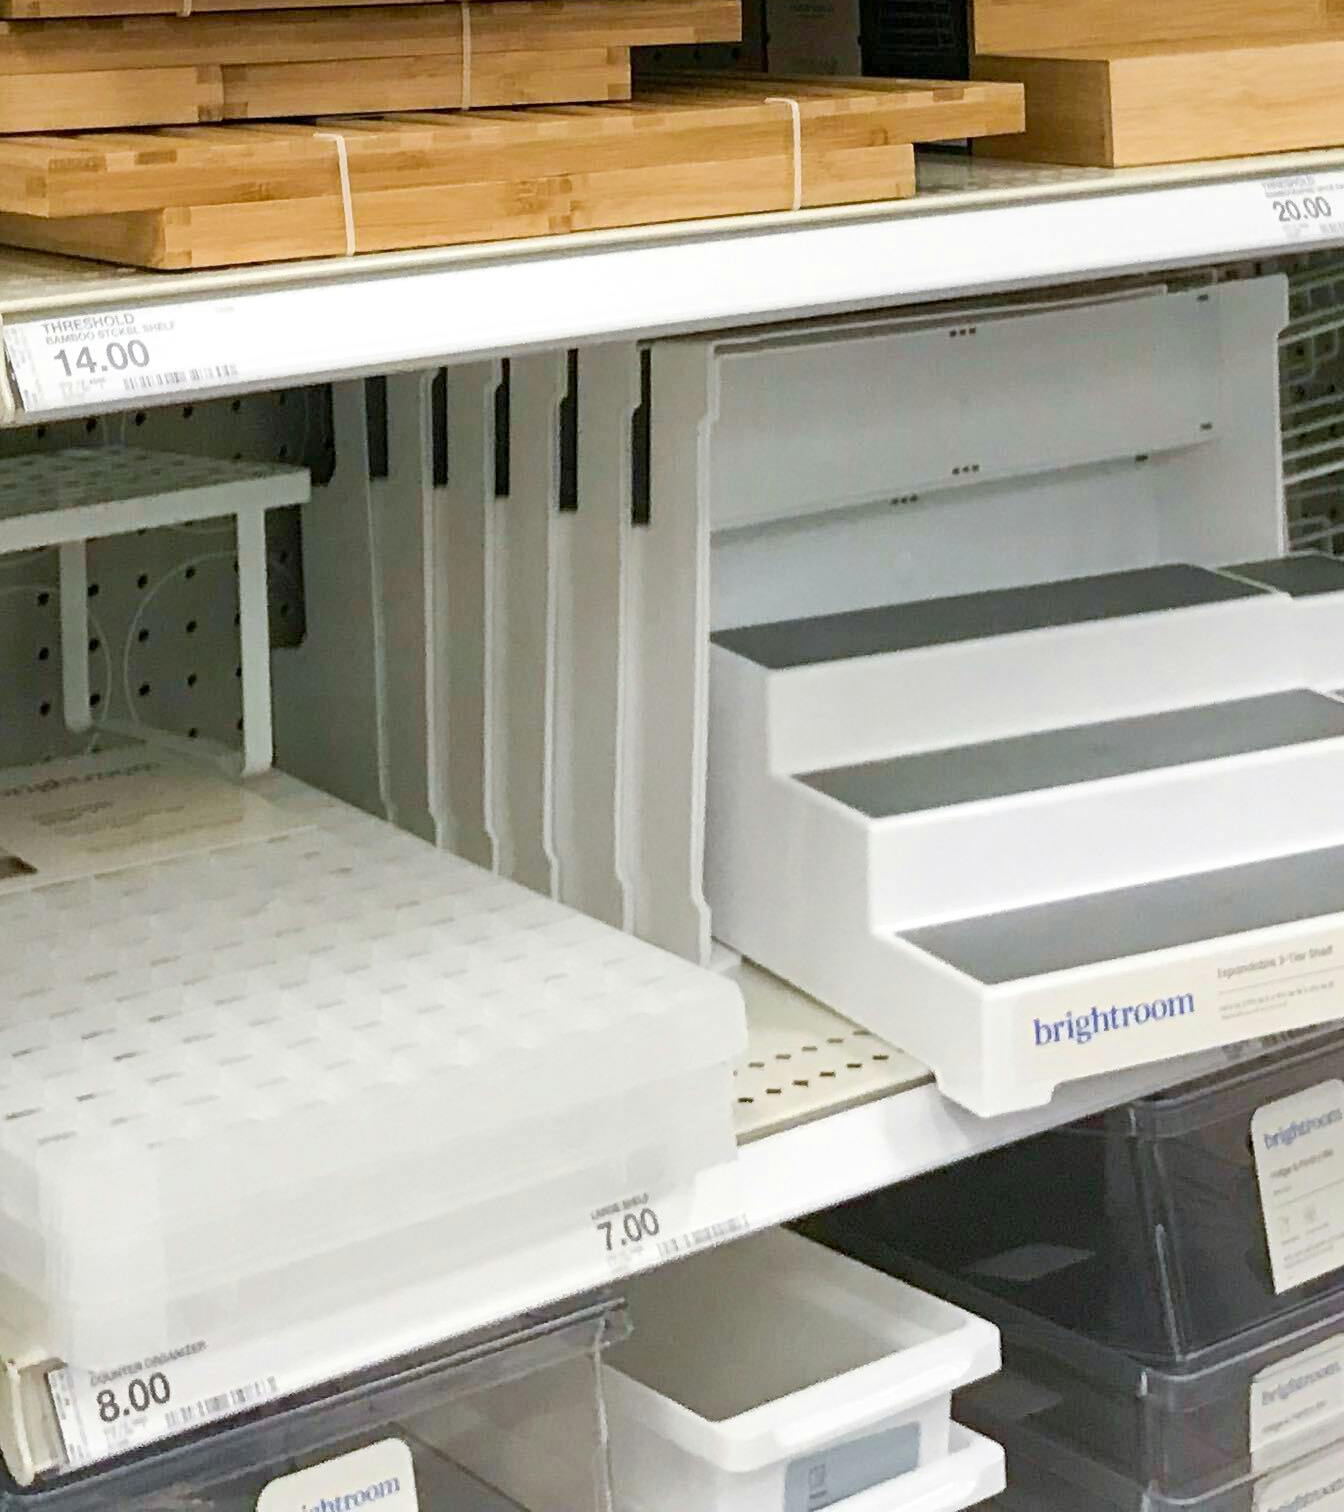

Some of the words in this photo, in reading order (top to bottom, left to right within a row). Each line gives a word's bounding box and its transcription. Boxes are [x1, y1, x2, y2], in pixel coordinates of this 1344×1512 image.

[1272, 195, 1332, 222] 20.00
[41, 312, 136, 336] THRESHOLD
[53, 339, 151, 377] 14.00
[1033, 991, 1196, 1048] brightroom
[1263, 1107, 1344, 1150] brightroom
[596, 1207, 660, 1251] 7.00
[96, 1371, 171, 1423] 8.00
